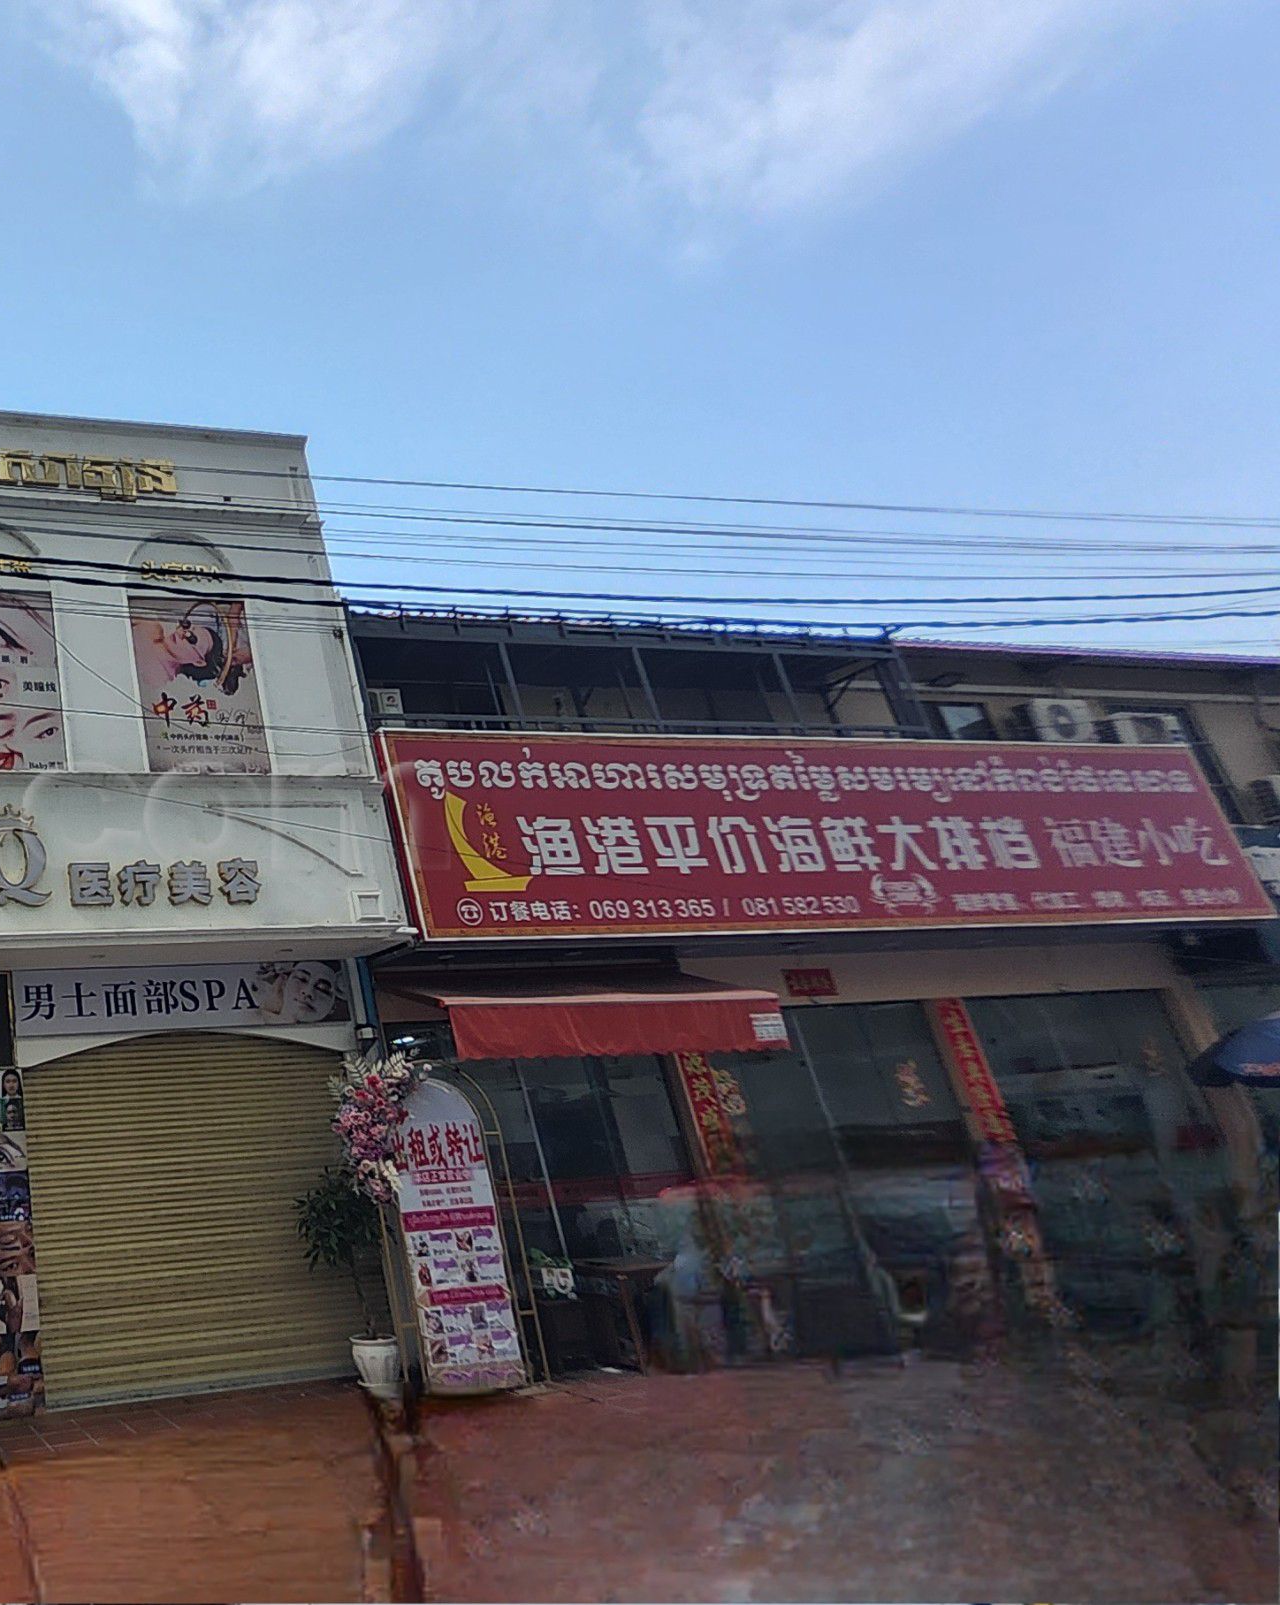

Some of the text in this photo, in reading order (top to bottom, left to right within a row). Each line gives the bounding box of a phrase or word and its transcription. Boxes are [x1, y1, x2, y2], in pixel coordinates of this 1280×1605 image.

[152, 691, 209, 728] 中药
[516, 814, 1041, 877] 渔港平价海鲜大排档
[68, 857, 264, 908] 医疗美容
[488, 899, 582, 923] 订餐电话：
[589, 898, 631, 921] 069
[633, 898, 676, 920] 313
[677, 897, 716, 919] 365
[20, 977, 261, 1022] 男士面部SPA
